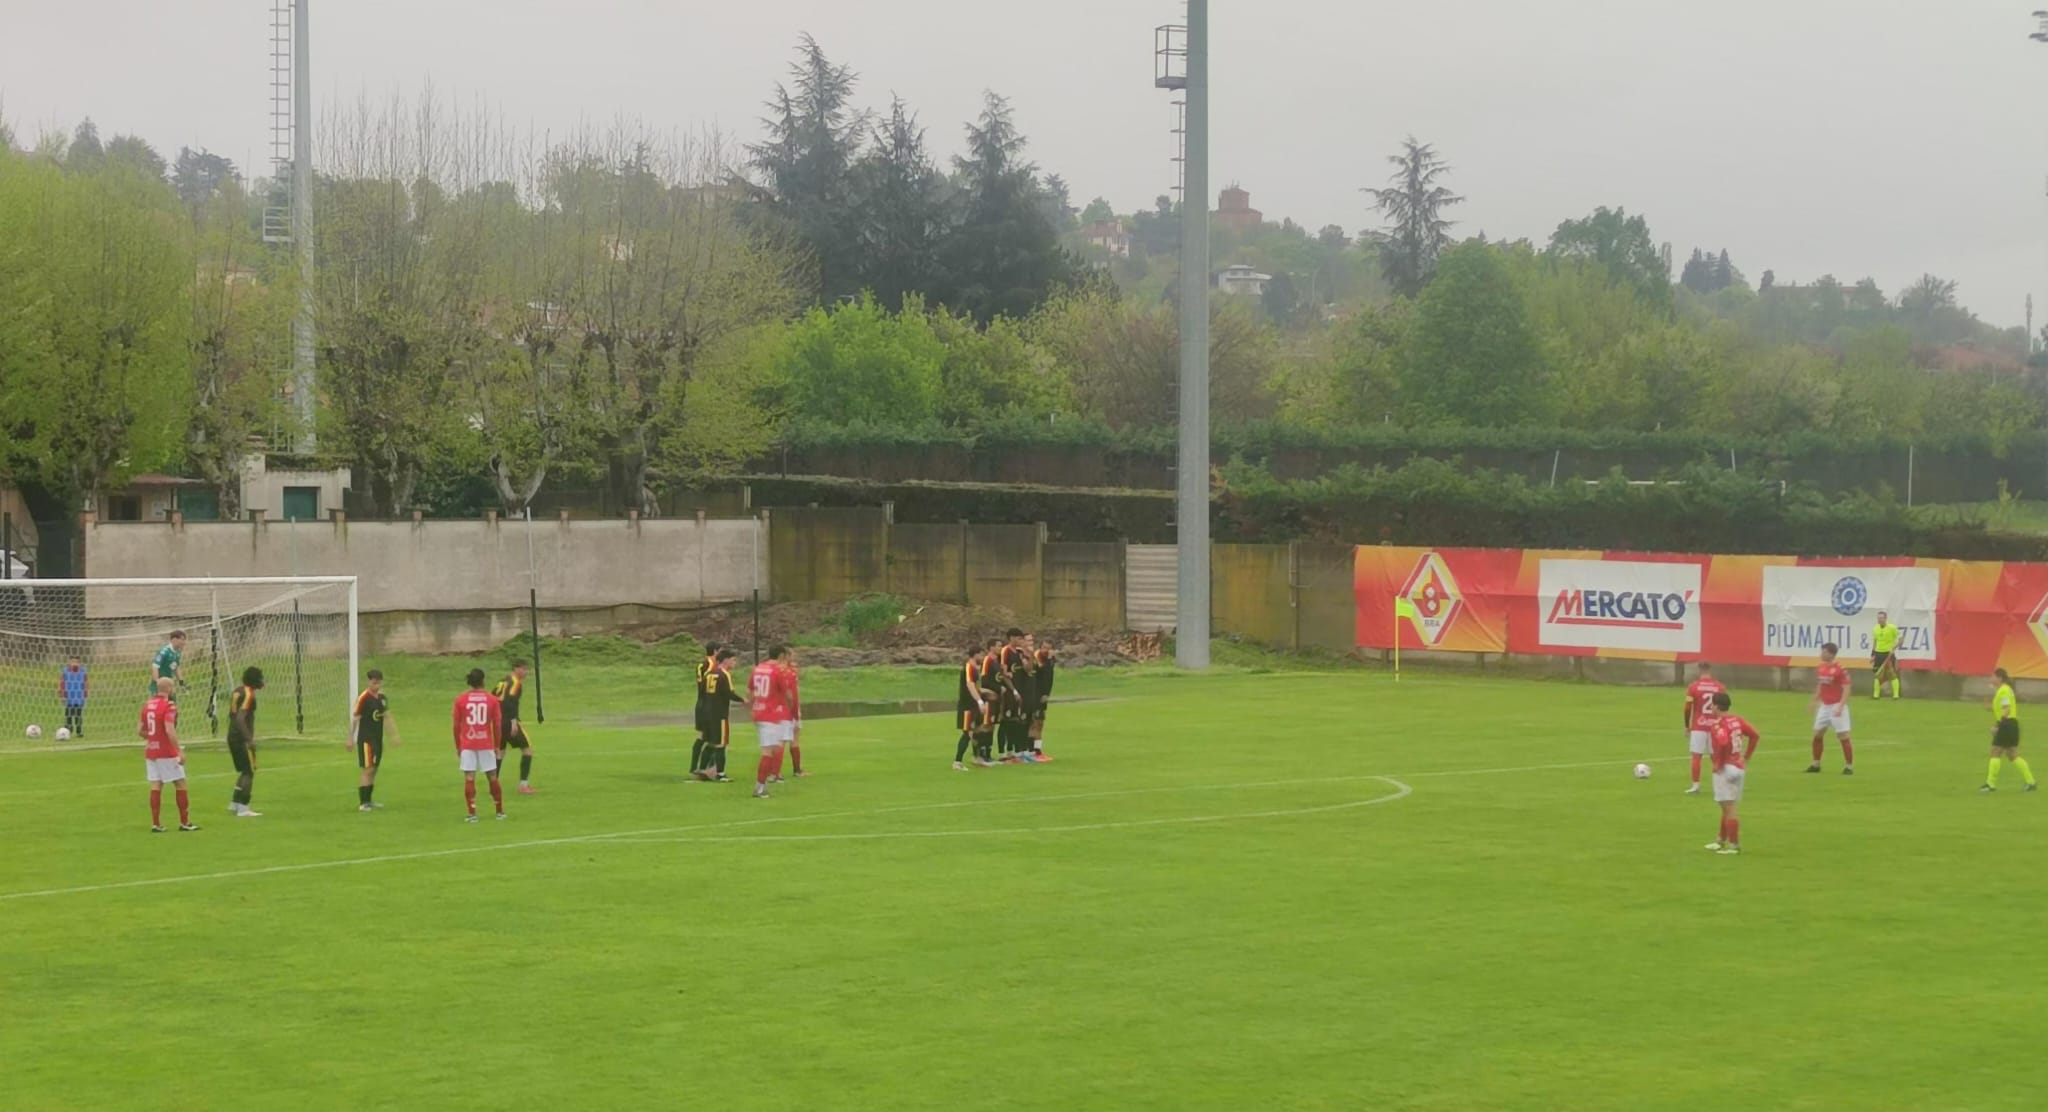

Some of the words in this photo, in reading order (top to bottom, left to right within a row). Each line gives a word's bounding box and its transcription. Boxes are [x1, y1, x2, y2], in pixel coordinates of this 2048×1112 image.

[1767, 623, 1851, 649] PIUMATTI
[1860, 632, 1870, 650] &
[752, 674, 771, 698] 50
[465, 702, 488, 726] 30
[1702, 693, 1714, 714] 2
[146, 711, 156, 735] 6
